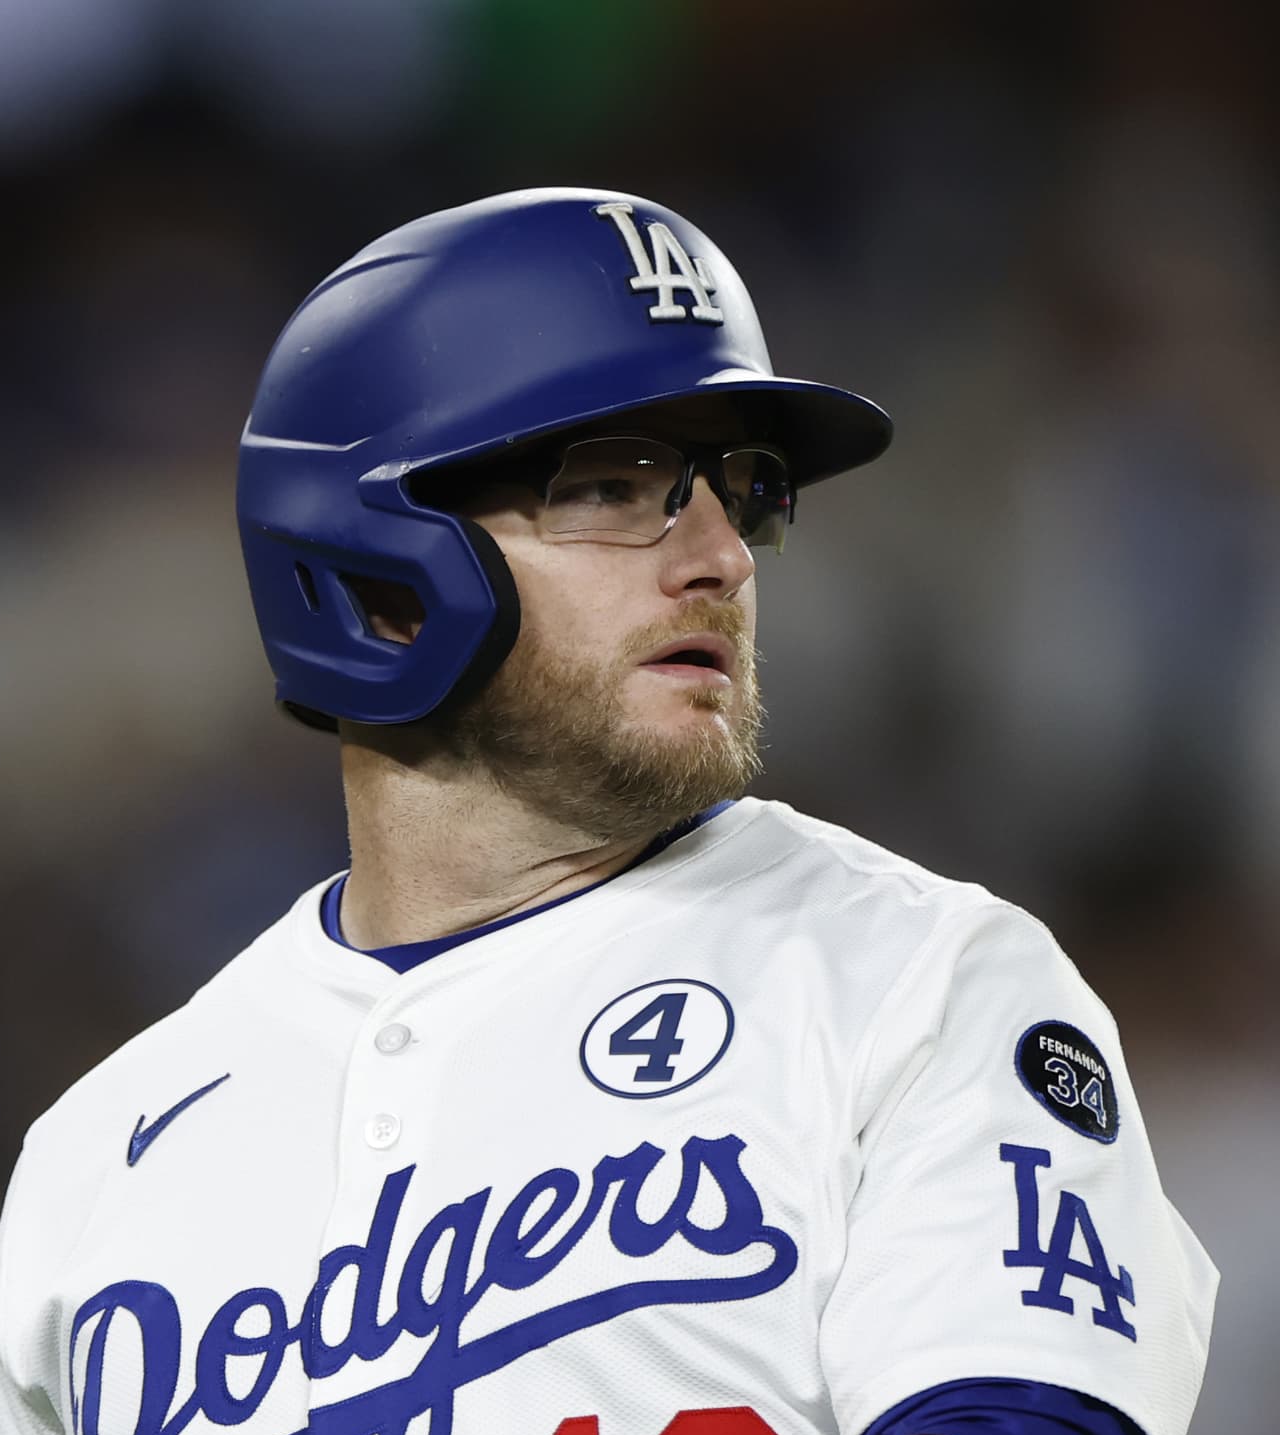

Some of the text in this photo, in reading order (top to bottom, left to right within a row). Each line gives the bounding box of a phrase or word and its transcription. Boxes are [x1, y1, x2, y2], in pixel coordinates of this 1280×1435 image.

[596, 202, 724, 324] LA
[608, 992, 689, 1082] 4
[1038, 1036, 1106, 1081] FERNANDO
[1045, 1057, 1107, 1128] 34
[999, 1142, 1137, 1343] LA
